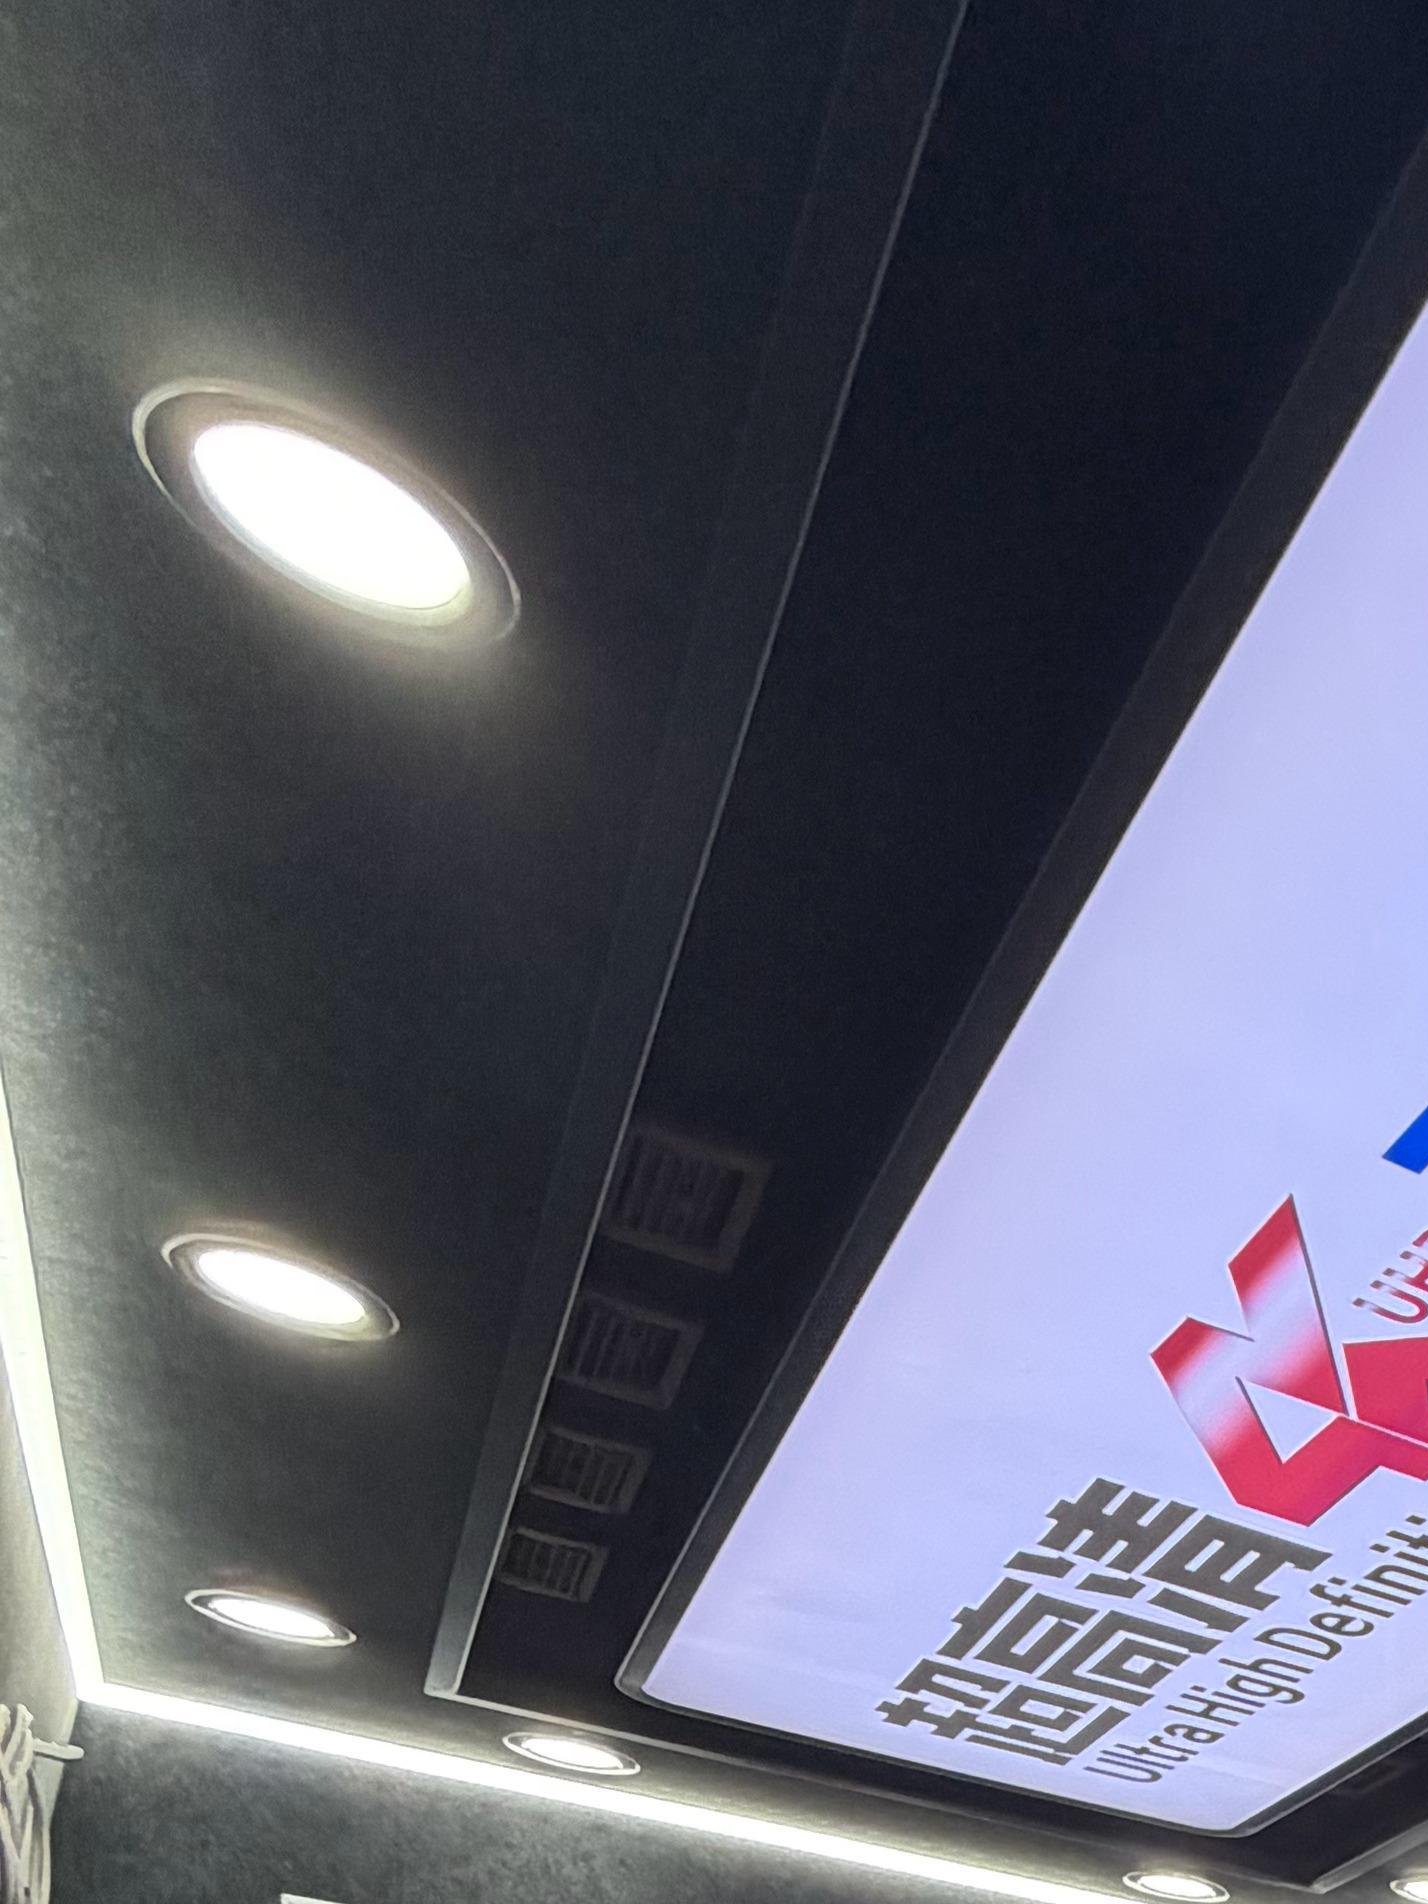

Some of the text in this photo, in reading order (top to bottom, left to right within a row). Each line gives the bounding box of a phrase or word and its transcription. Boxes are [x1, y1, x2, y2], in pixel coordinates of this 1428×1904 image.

[875, 1476, 1334, 1766] 超高清
[1084, 1720, 1226, 1784] Ultra
[1165, 1655, 1314, 1729] High
